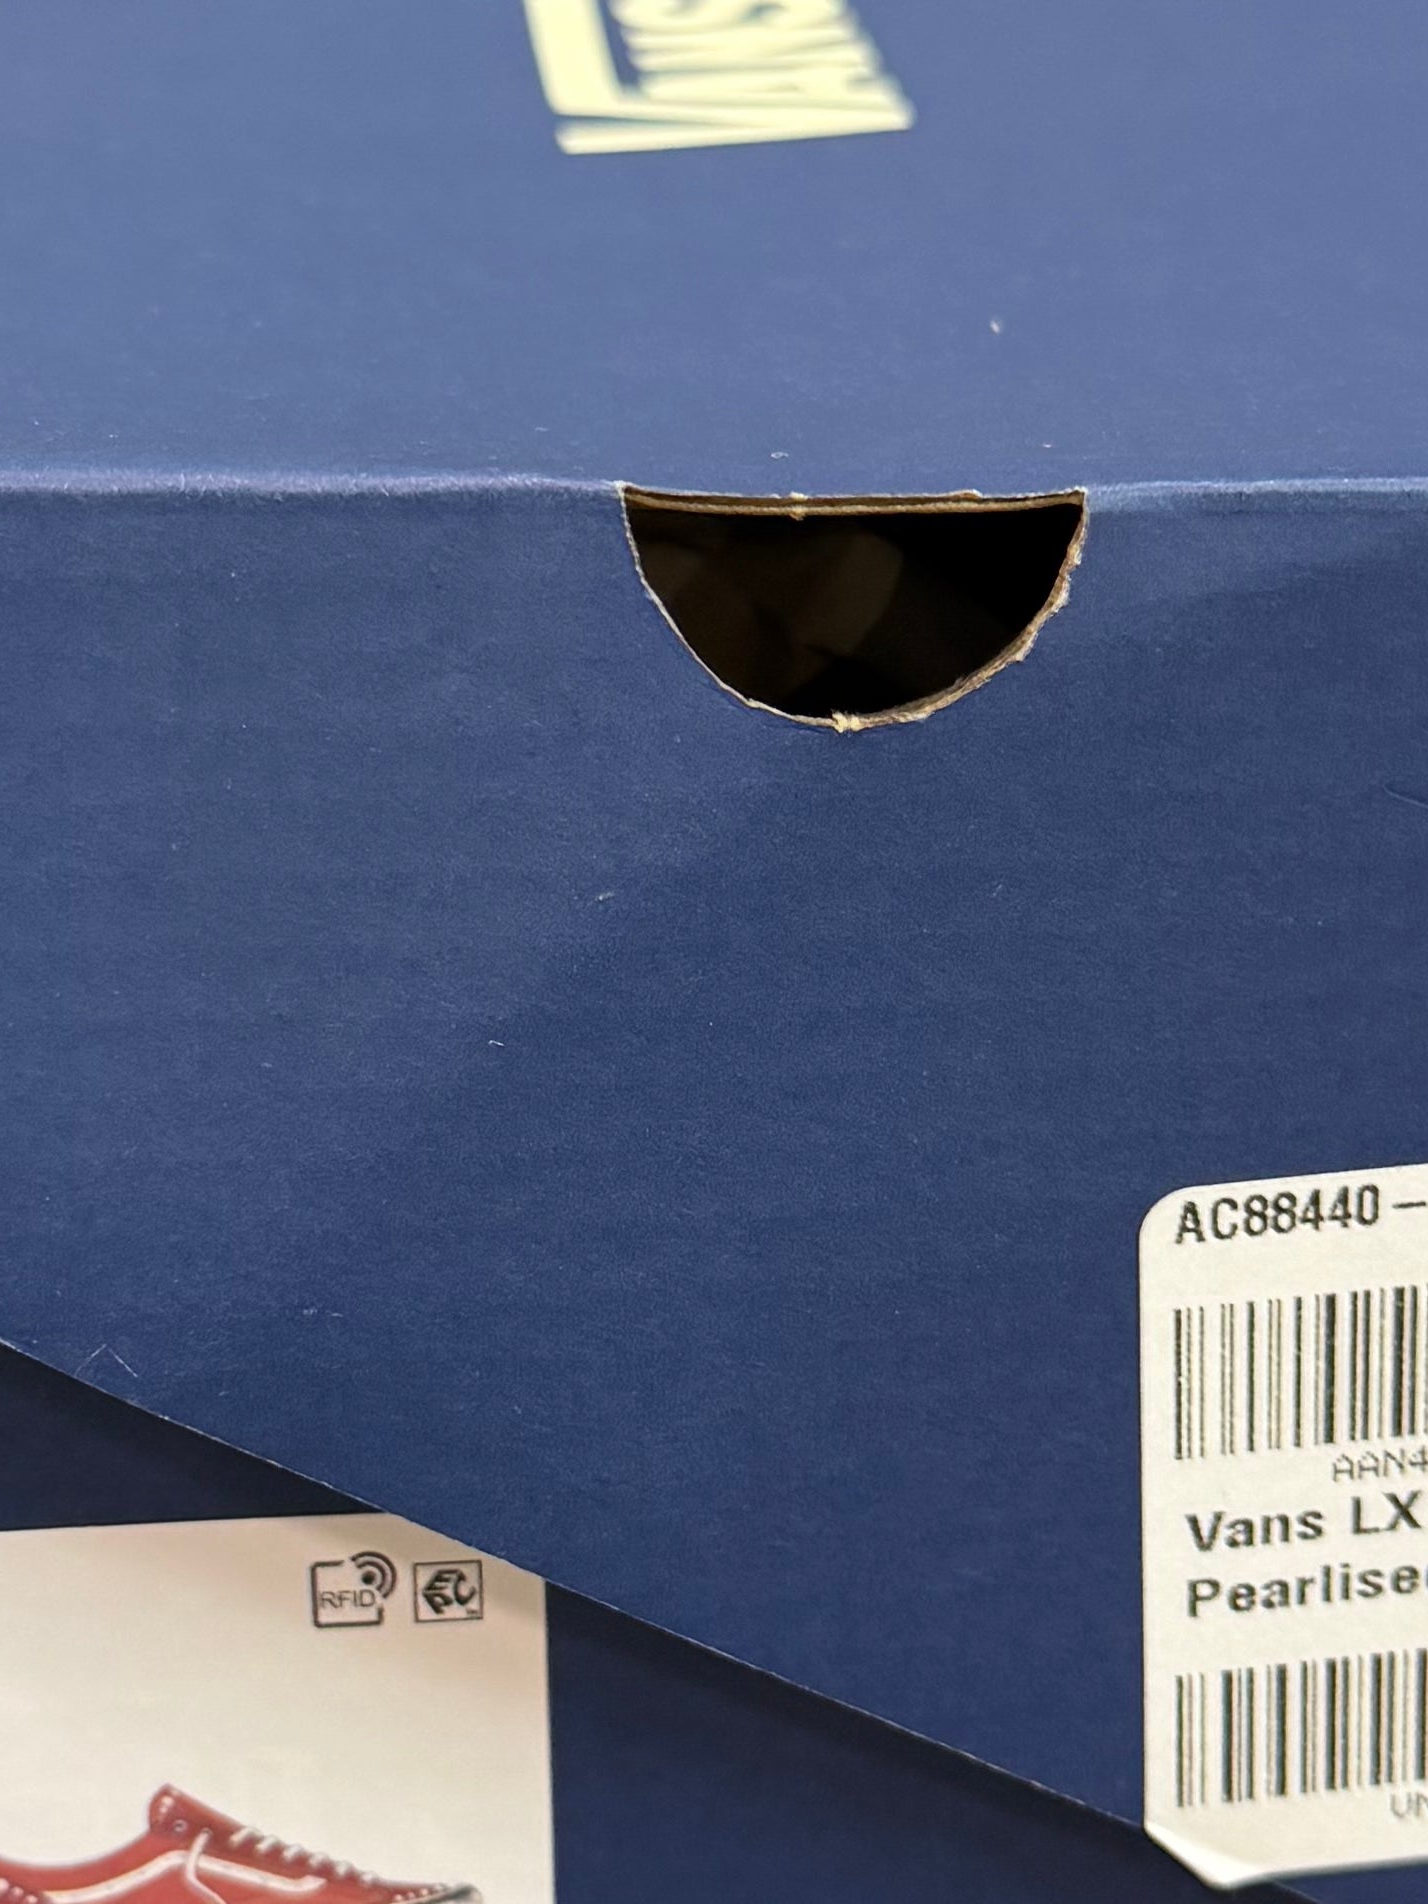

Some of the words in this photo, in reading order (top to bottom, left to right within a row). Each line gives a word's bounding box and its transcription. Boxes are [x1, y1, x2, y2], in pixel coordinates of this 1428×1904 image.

[1186, 1509, 1324, 1552] Vans
[1351, 1491, 1422, 1534] LX
[321, 1589, 375, 1609] RFID
